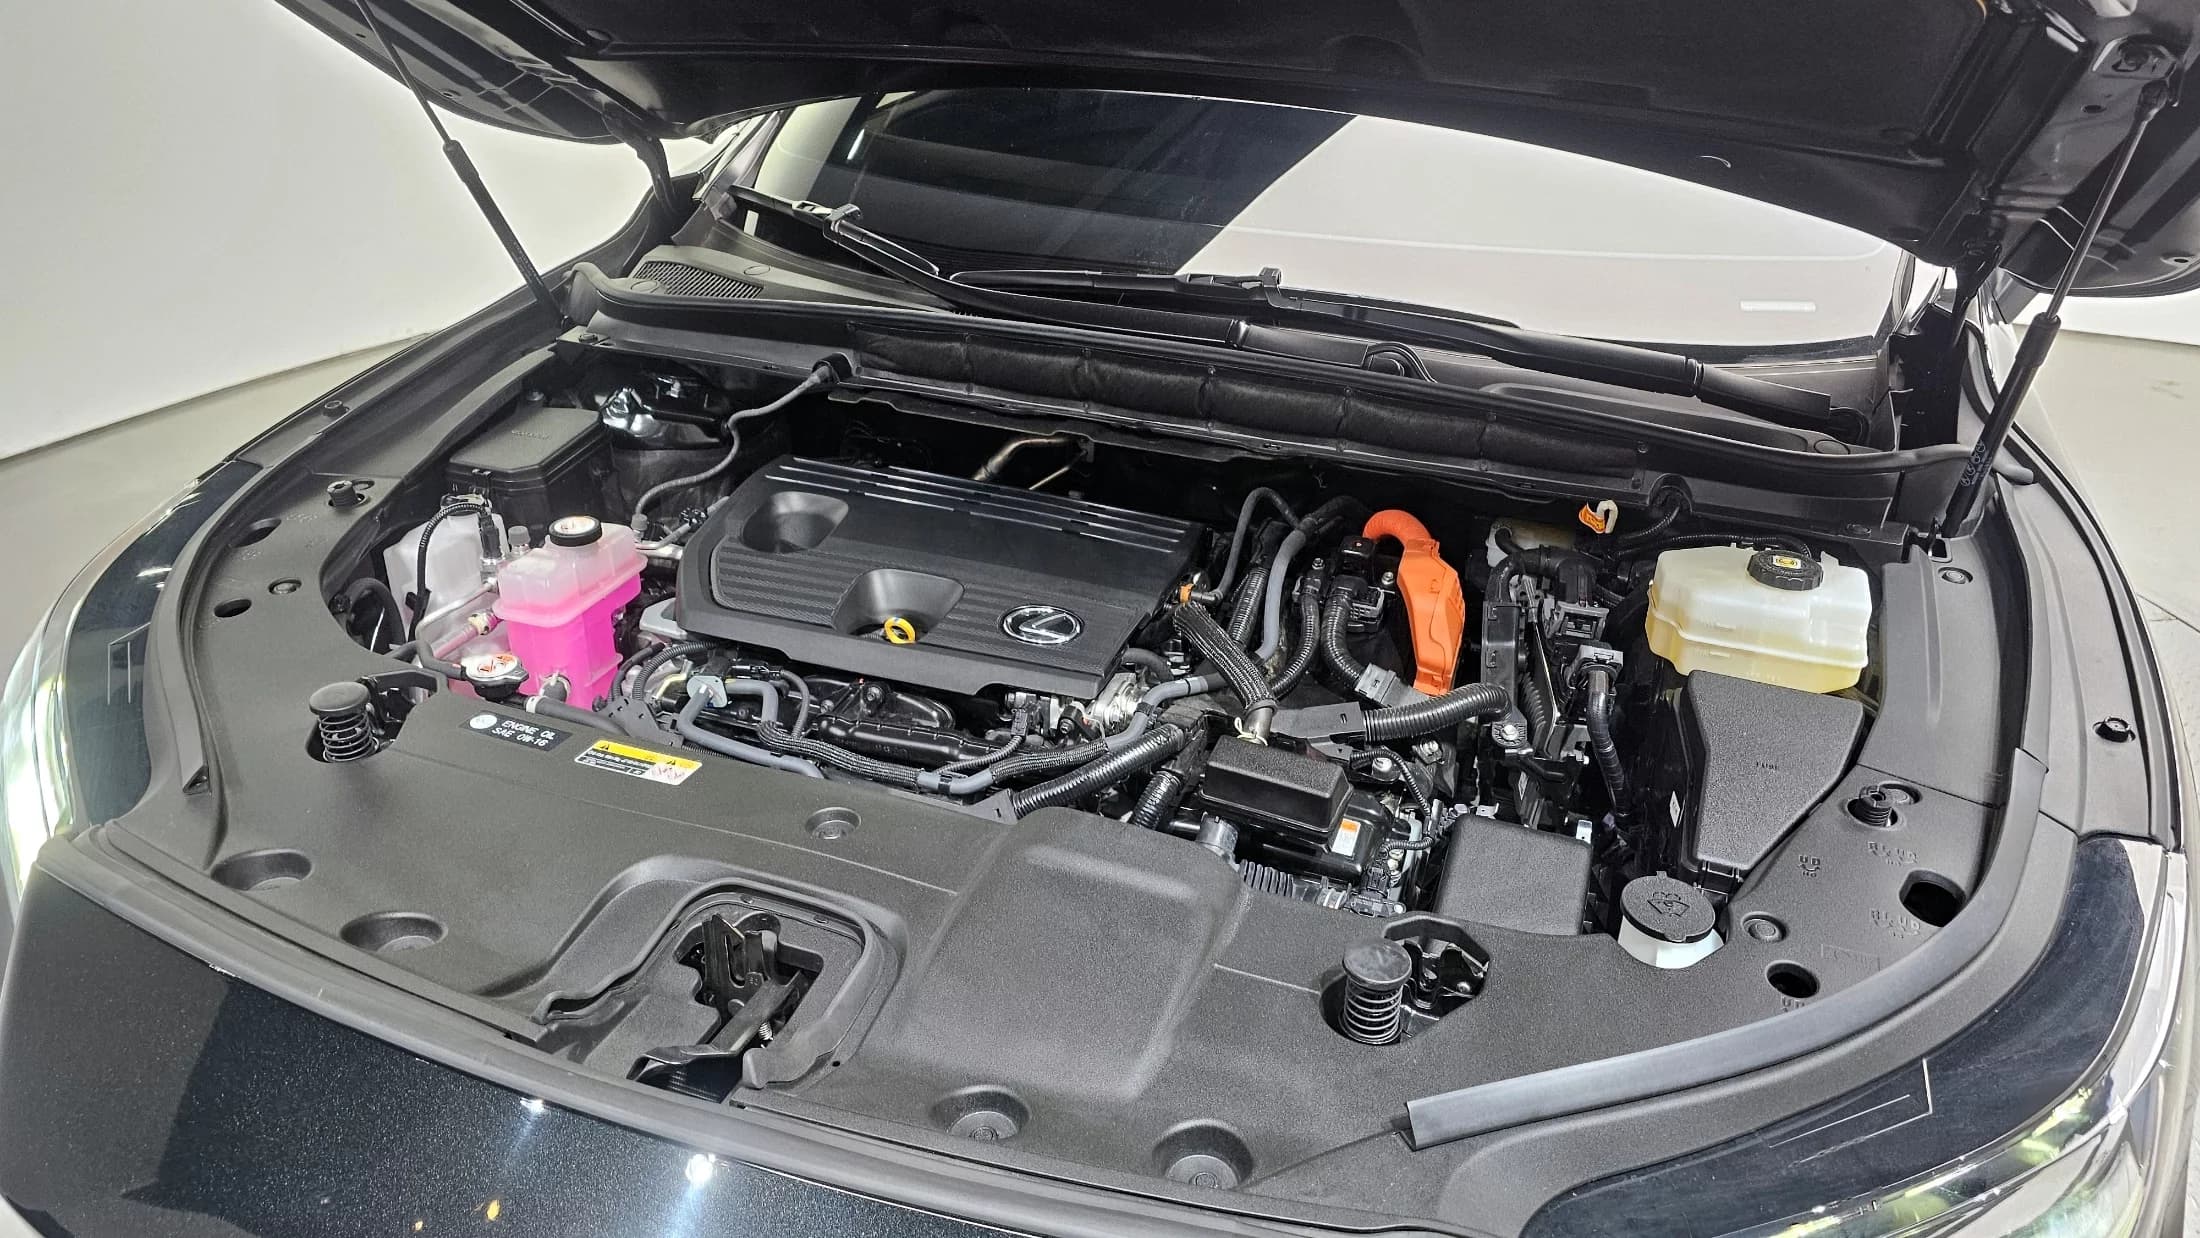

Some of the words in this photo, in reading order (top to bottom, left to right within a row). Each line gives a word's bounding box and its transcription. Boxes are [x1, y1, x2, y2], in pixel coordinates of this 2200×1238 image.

[491, 727, 515, 738] SAE
[501, 720, 539, 735] ENGINE
[540, 730, 556, 740] OIL
